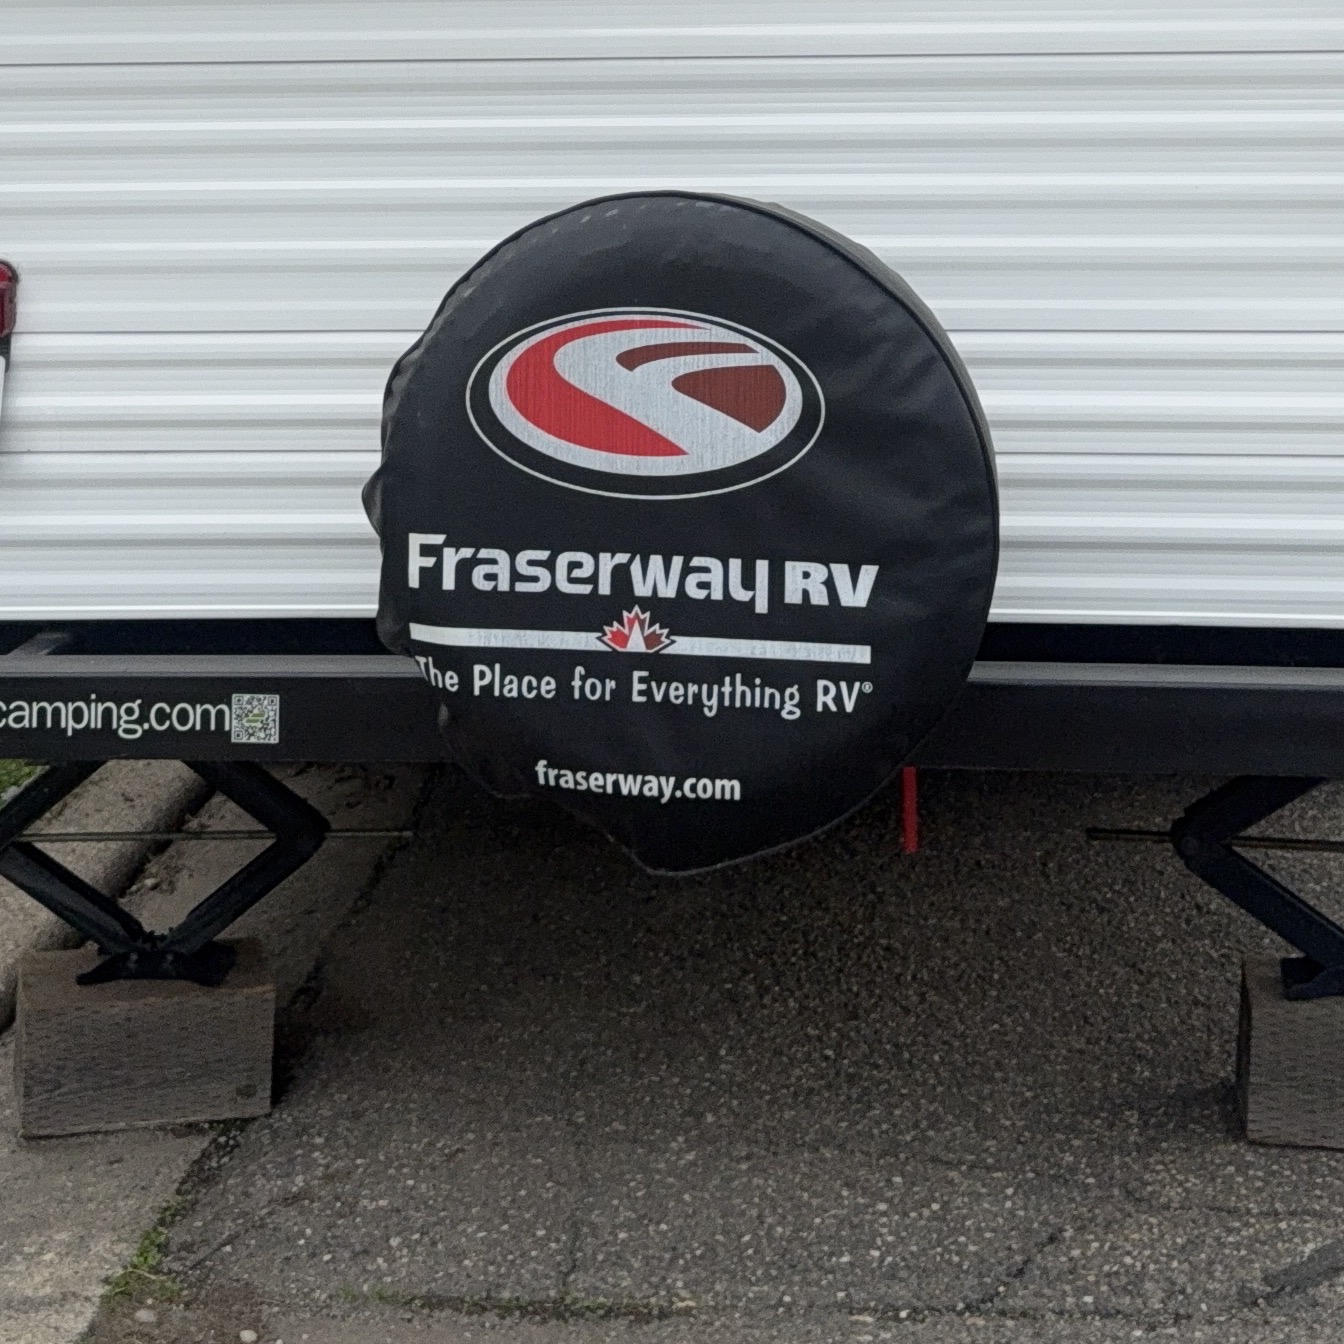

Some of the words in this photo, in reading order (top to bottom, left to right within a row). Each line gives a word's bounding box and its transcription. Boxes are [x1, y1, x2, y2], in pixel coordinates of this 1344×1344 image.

[408, 532, 769, 614] Fraserway
[784, 560, 880, 608] RV
[473, 663, 556, 699] Place
[571, 666, 616, 701] for
[631, 670, 801, 720] Everything
[533, 759, 742, 803] fraserway.com
